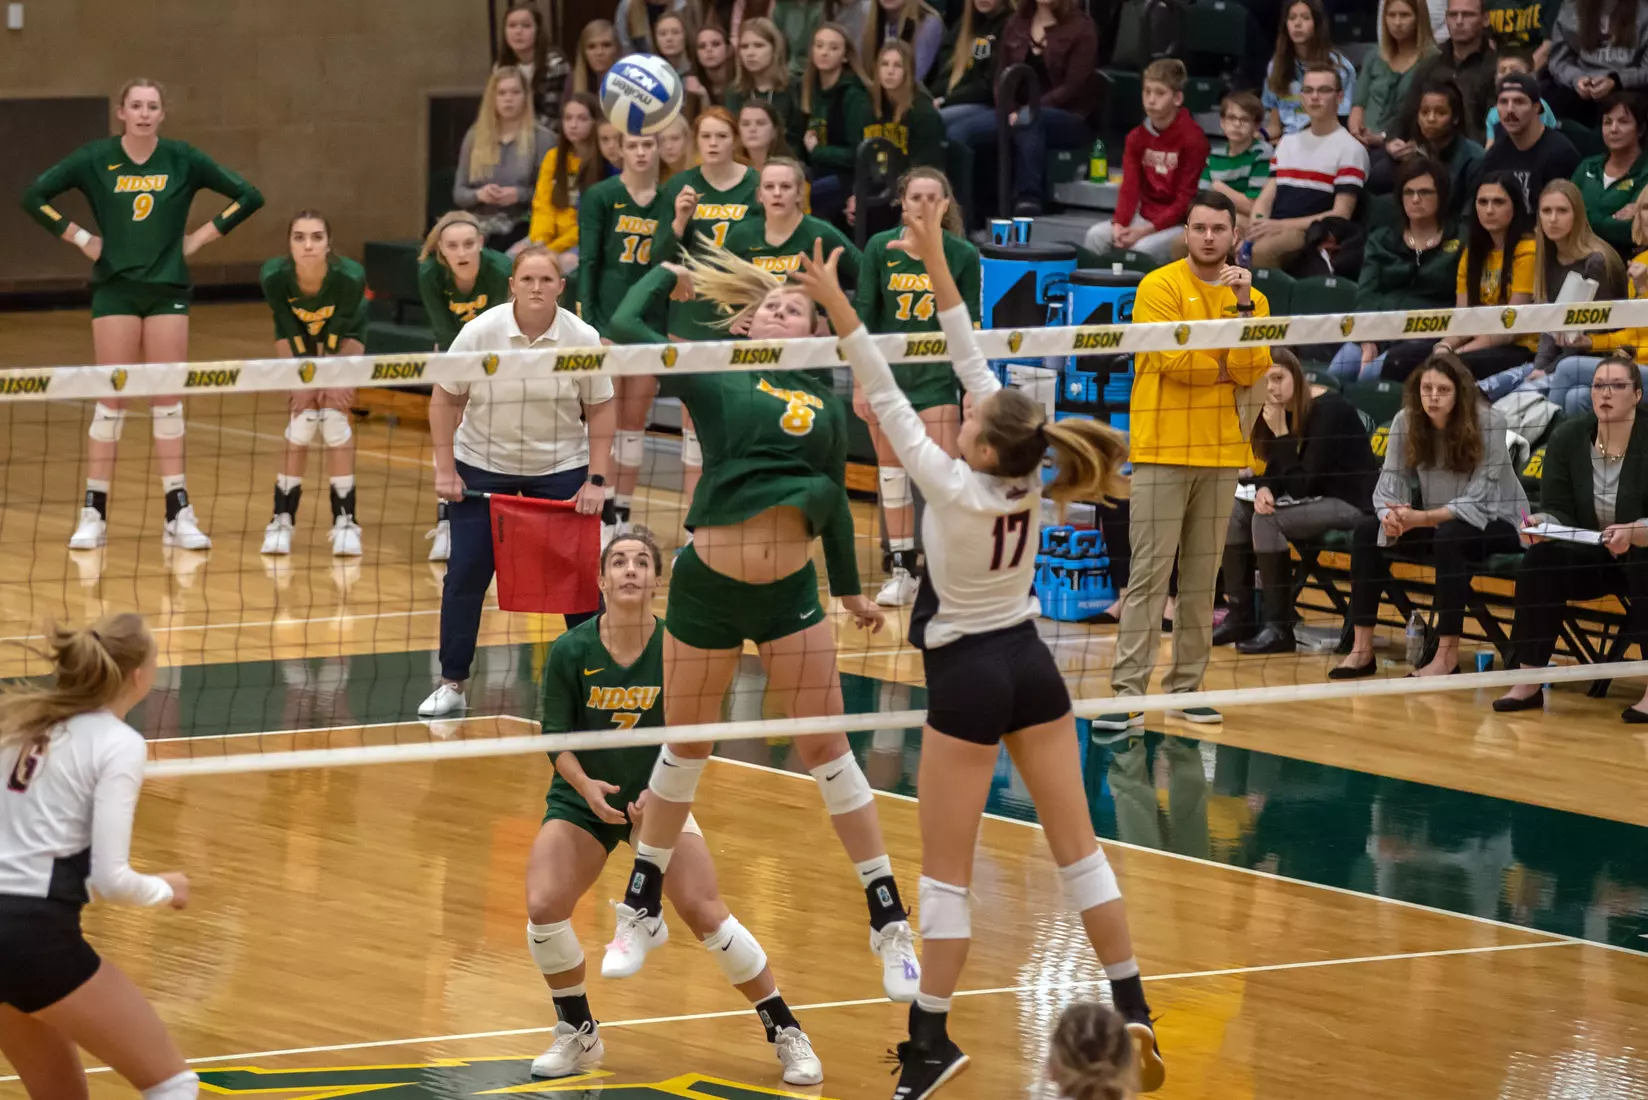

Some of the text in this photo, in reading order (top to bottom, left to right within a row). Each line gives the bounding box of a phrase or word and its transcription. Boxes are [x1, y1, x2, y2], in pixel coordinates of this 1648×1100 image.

[611, 77, 653, 105] molten
[114, 174, 168, 193] NDSU
[132, 193, 154, 221] 9
[692, 204, 749, 221] NDSU
[711, 221, 730, 249] 1
[619, 235, 653, 265] 10
[895, 293, 935, 321] 14
[184, 367, 241, 387] BISON
[371, 361, 426, 380] BISON
[552, 352, 606, 372] BISON
[730, 347, 782, 365] BISON
[1073, 331, 1125, 350] BISON
[1240, 323, 1289, 341] BISON
[1403, 314, 1452, 333] BISON
[1564, 307, 1613, 325] BISON
[779, 405, 816, 436] 8
[989, 508, 1032, 571] 17
[586, 685, 661, 711] NDSU
